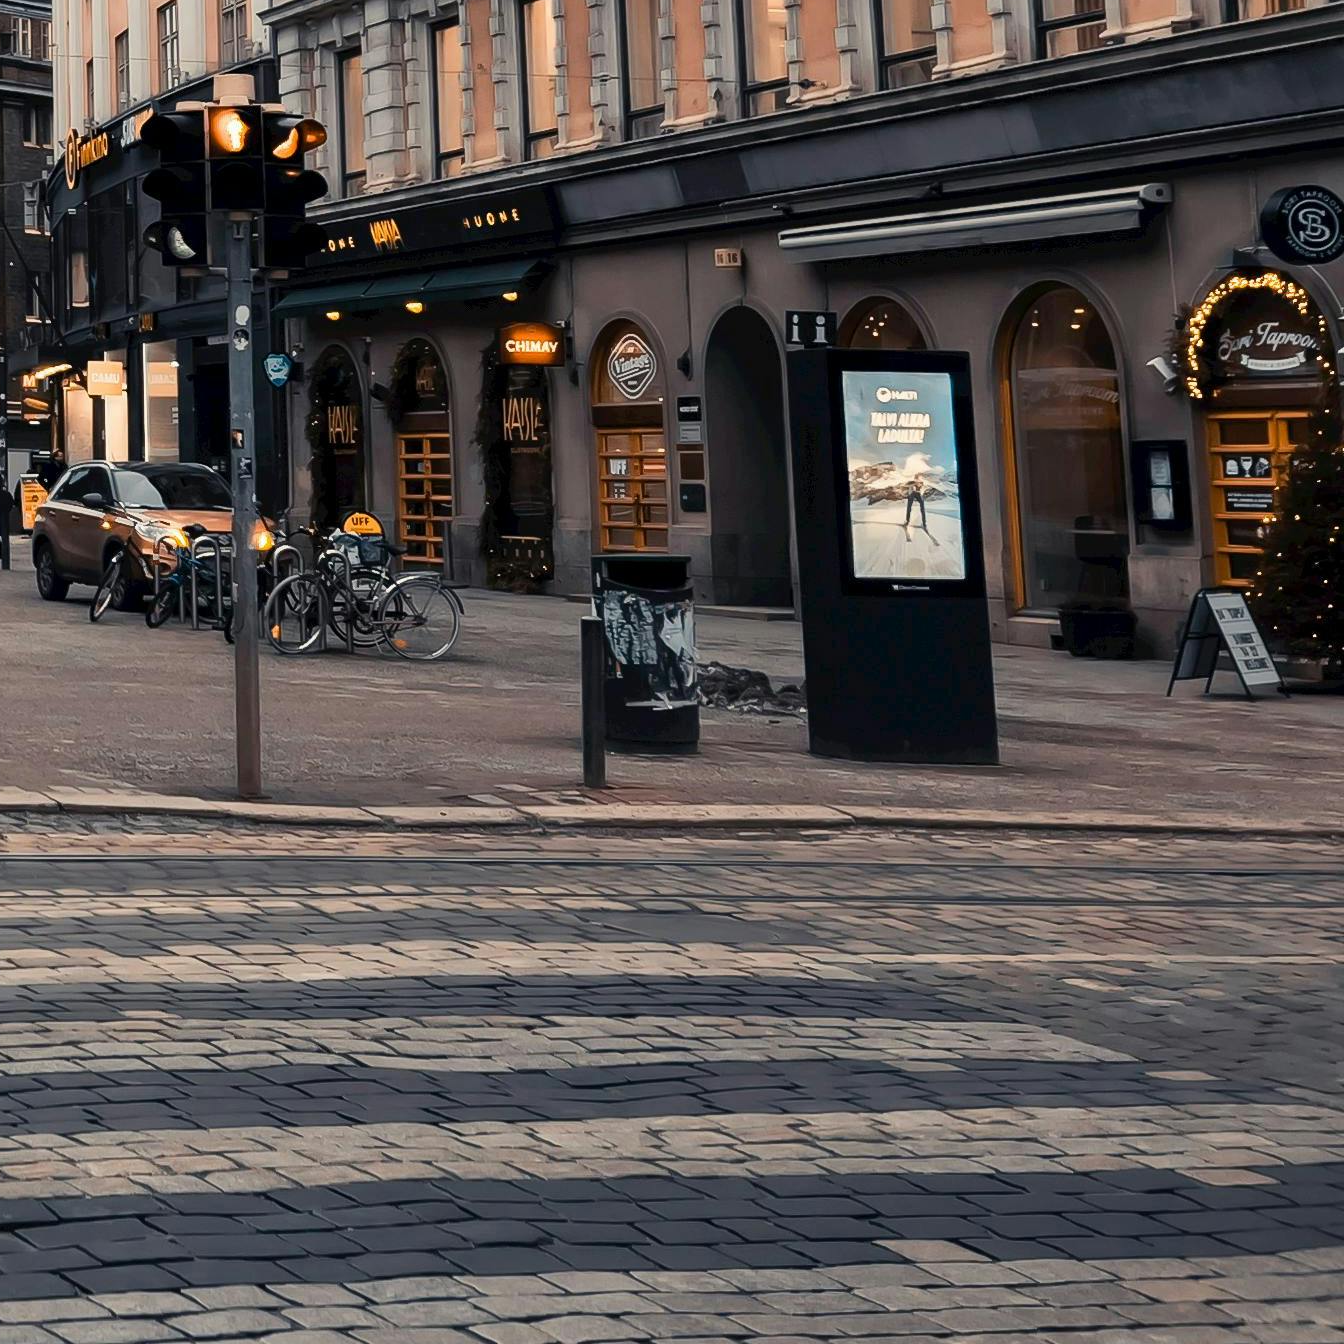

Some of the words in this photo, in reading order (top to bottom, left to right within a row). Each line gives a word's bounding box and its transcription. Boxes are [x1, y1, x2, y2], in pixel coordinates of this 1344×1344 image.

[505, 339, 559, 354] CHIMAY
[614, 353, 650, 374] Vintage
[351, 516, 370, 526] UFF
